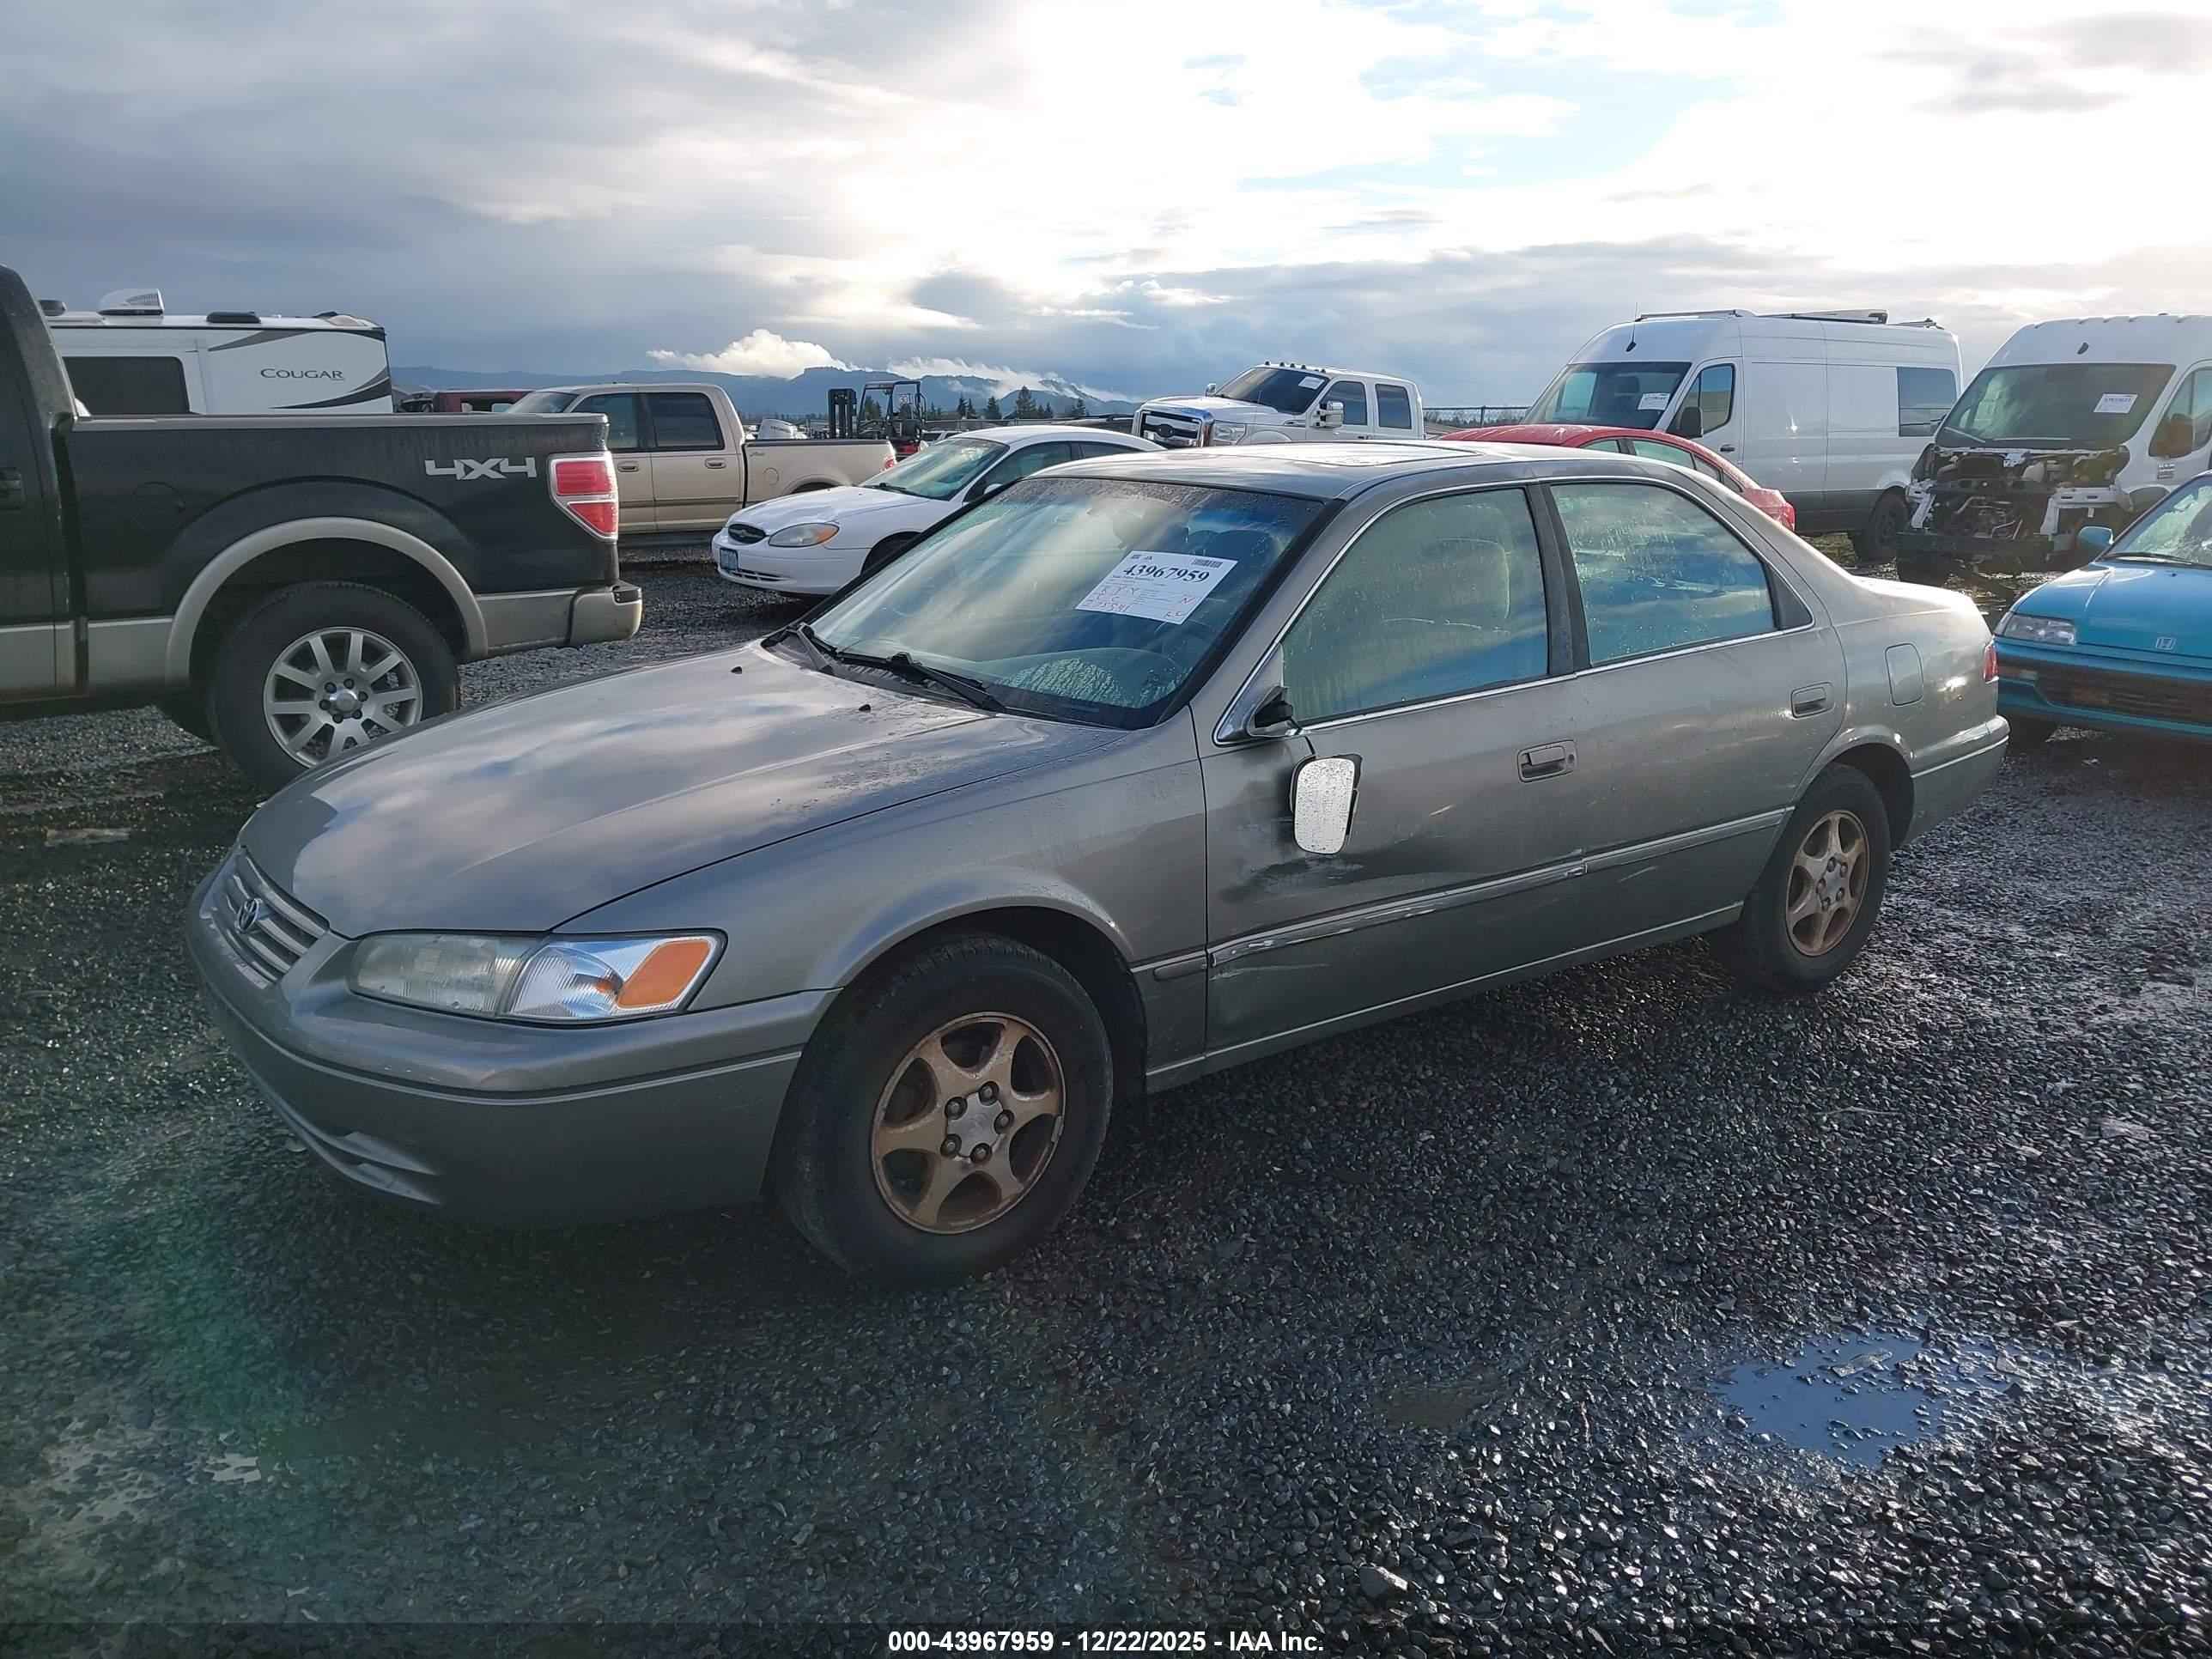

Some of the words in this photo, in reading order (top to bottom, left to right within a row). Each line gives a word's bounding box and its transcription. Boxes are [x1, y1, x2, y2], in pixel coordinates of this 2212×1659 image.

[260, 368, 344, 380] COUGAR
[424, 457, 538, 481] 4X4
[1122, 563, 1210, 583] 43967959
